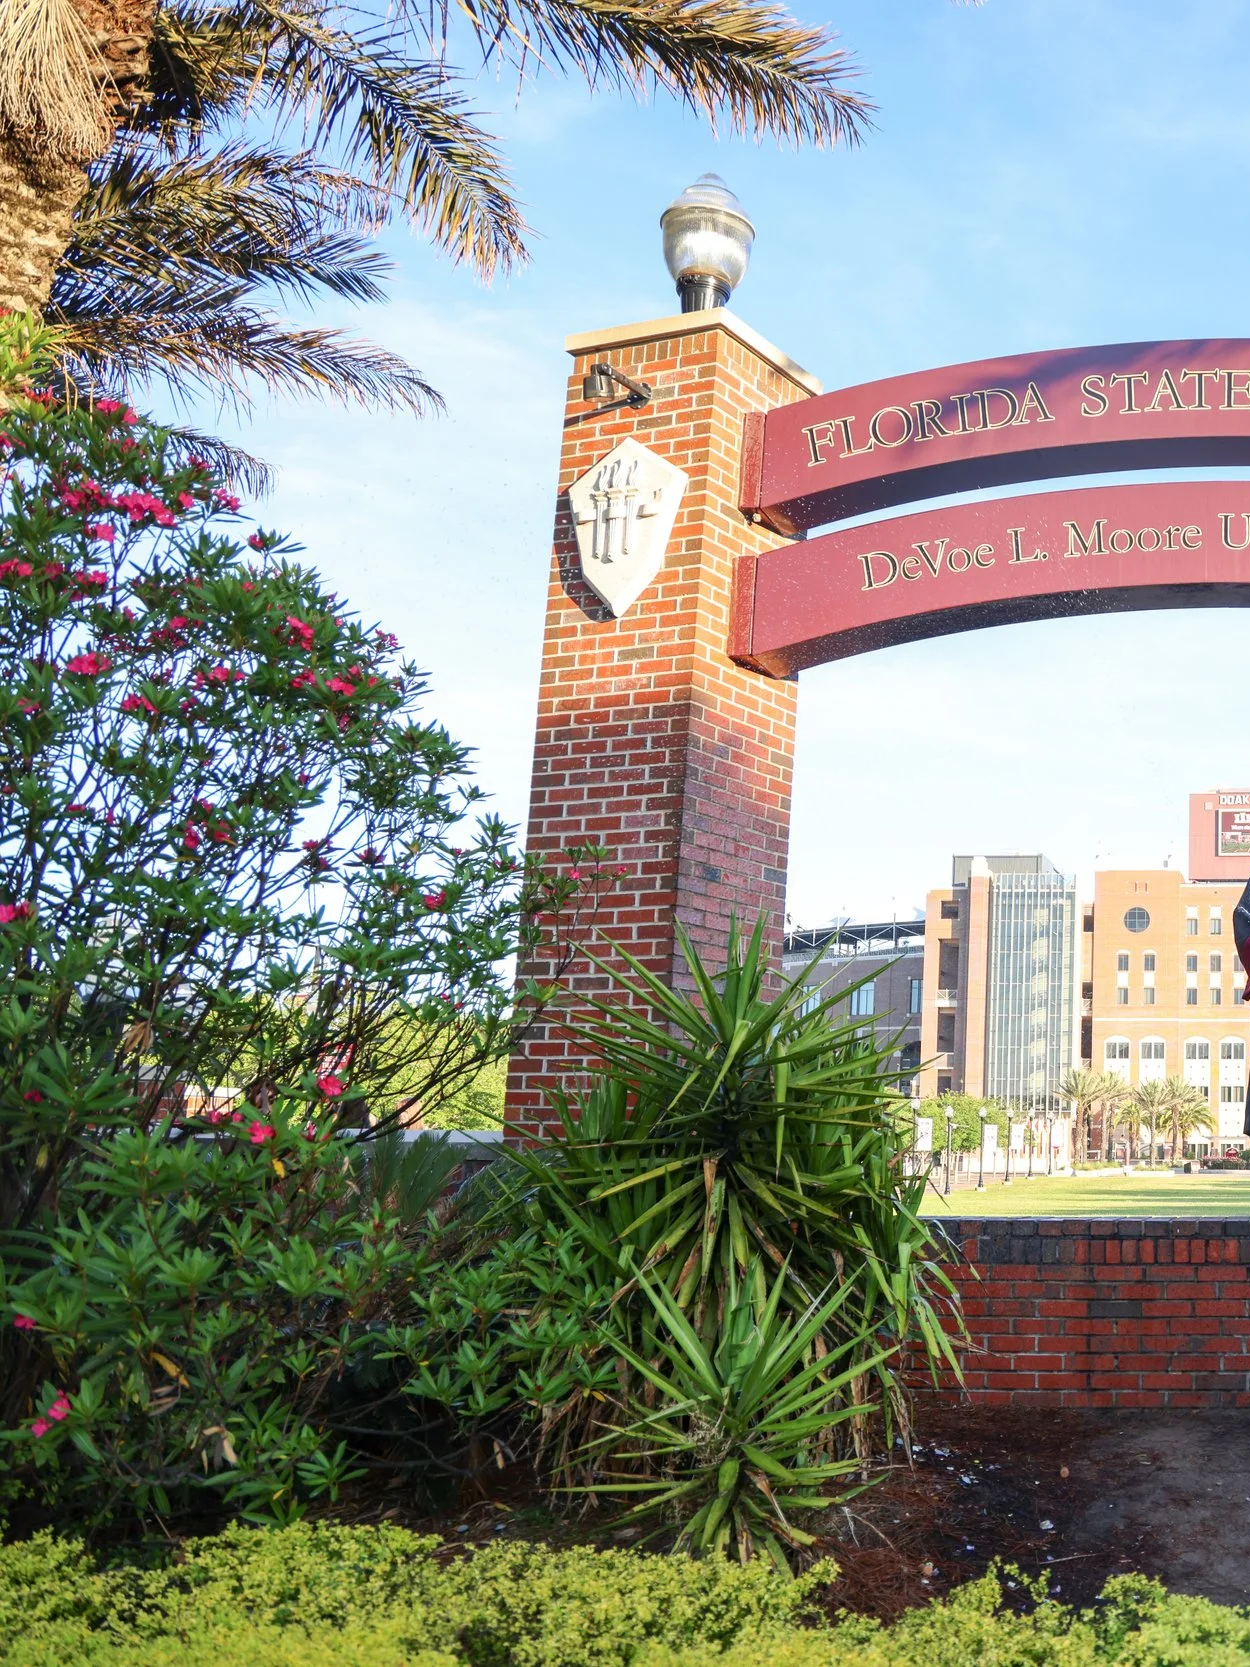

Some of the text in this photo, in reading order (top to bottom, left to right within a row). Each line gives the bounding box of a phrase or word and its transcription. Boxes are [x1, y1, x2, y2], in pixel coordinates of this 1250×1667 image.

[802, 382, 1055, 466] FLORIDA
[858, 538, 995, 591] DeVoe
[1007, 527, 1049, 564] L.
[1064, 518, 1202, 558] Moore
[1218, 795, 1249, 805] DOAK
